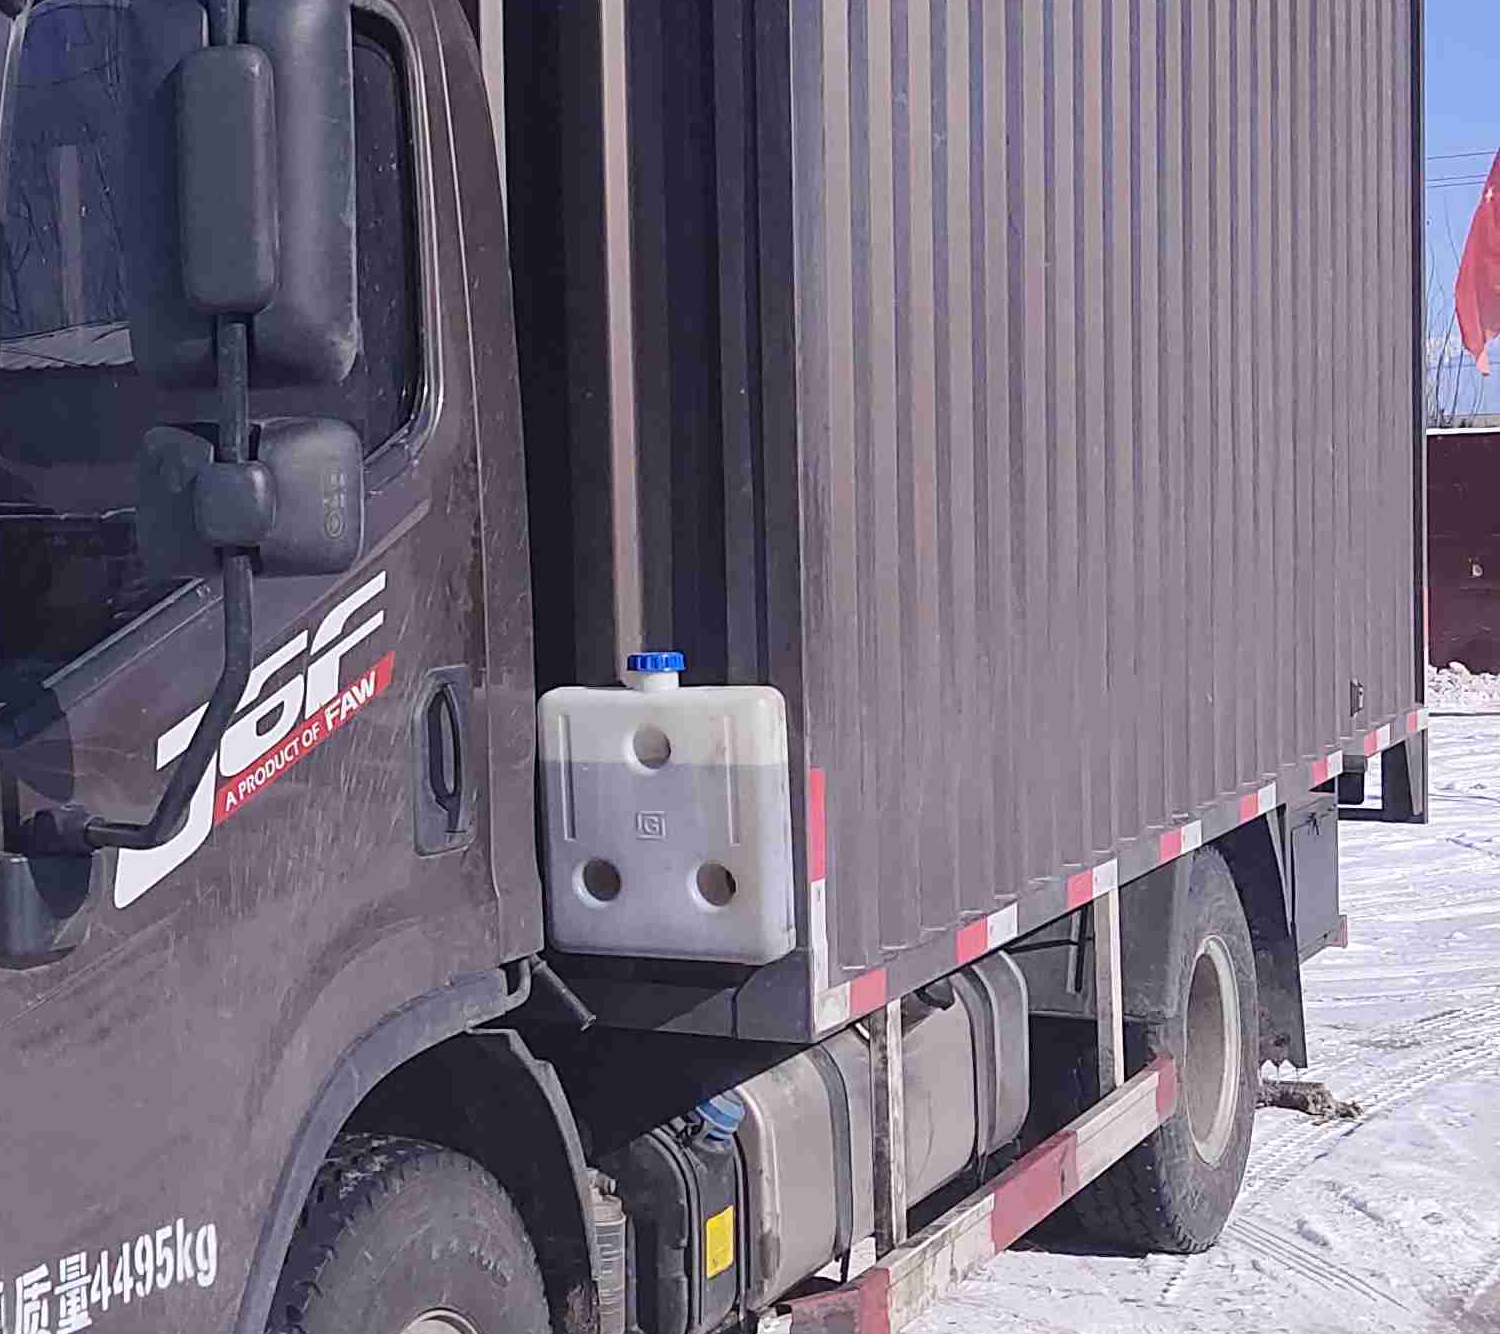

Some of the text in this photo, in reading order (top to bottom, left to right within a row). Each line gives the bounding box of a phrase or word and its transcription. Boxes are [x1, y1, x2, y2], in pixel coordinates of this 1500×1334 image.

[225, 670, 376, 812] A PRODUCT OF FAW
